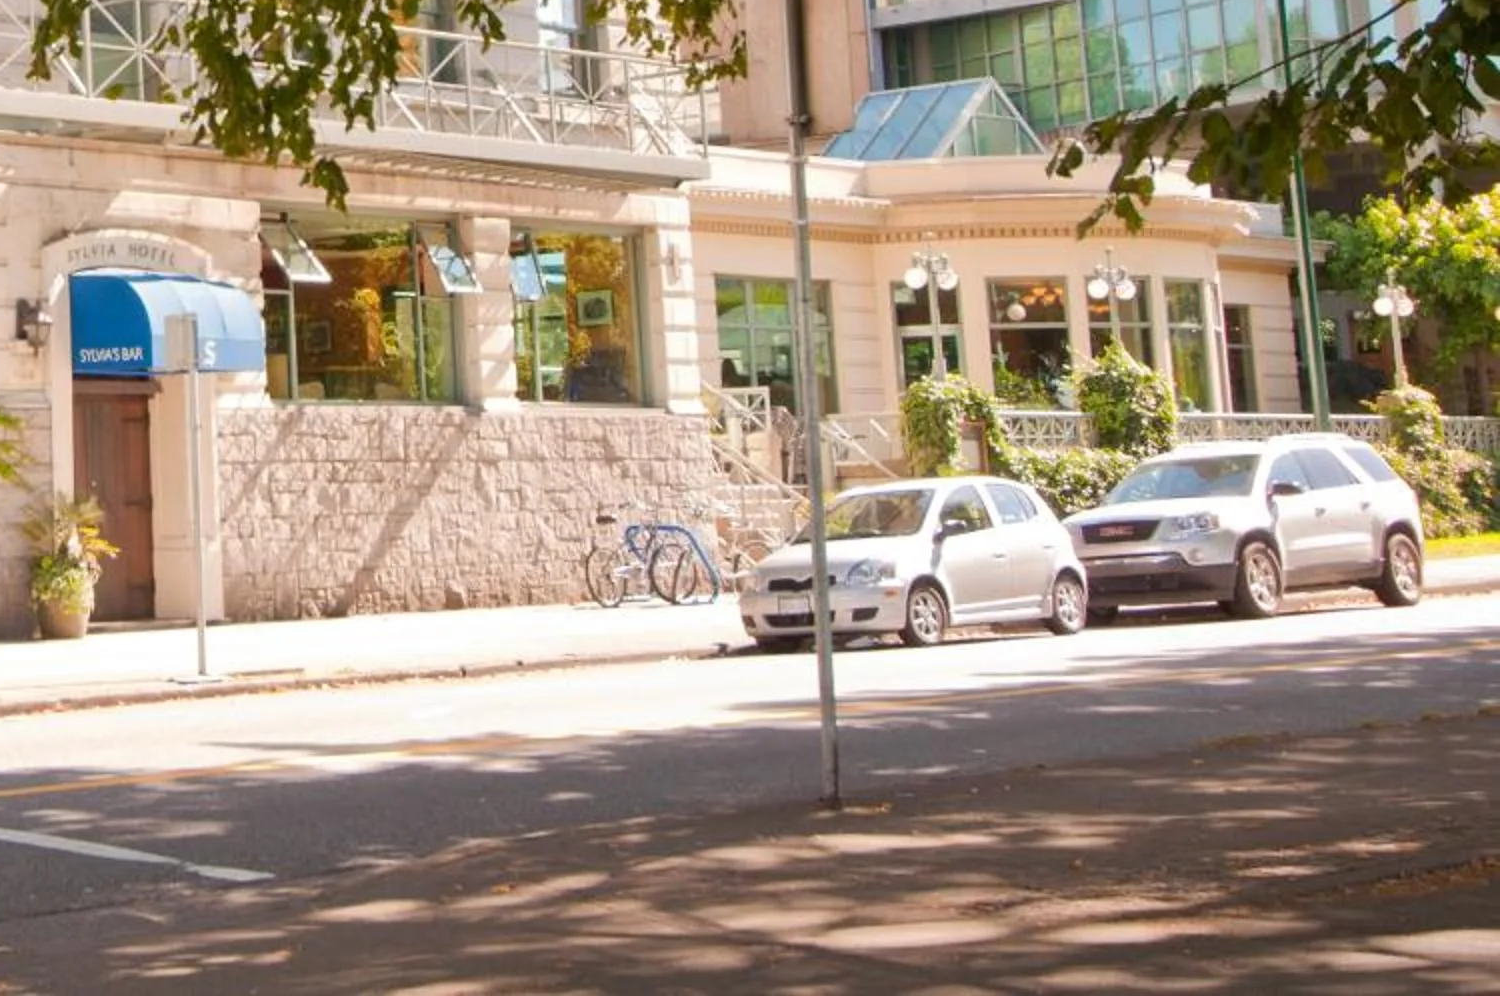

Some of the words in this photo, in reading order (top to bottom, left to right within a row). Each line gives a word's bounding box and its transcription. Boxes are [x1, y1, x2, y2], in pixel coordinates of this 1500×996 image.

[67, 244, 117, 263] SYLVIA
[128, 244, 176, 267] HOTEL
[79, 348, 120, 363] SYLVIA'S
[121, 347, 145, 361] BAR
